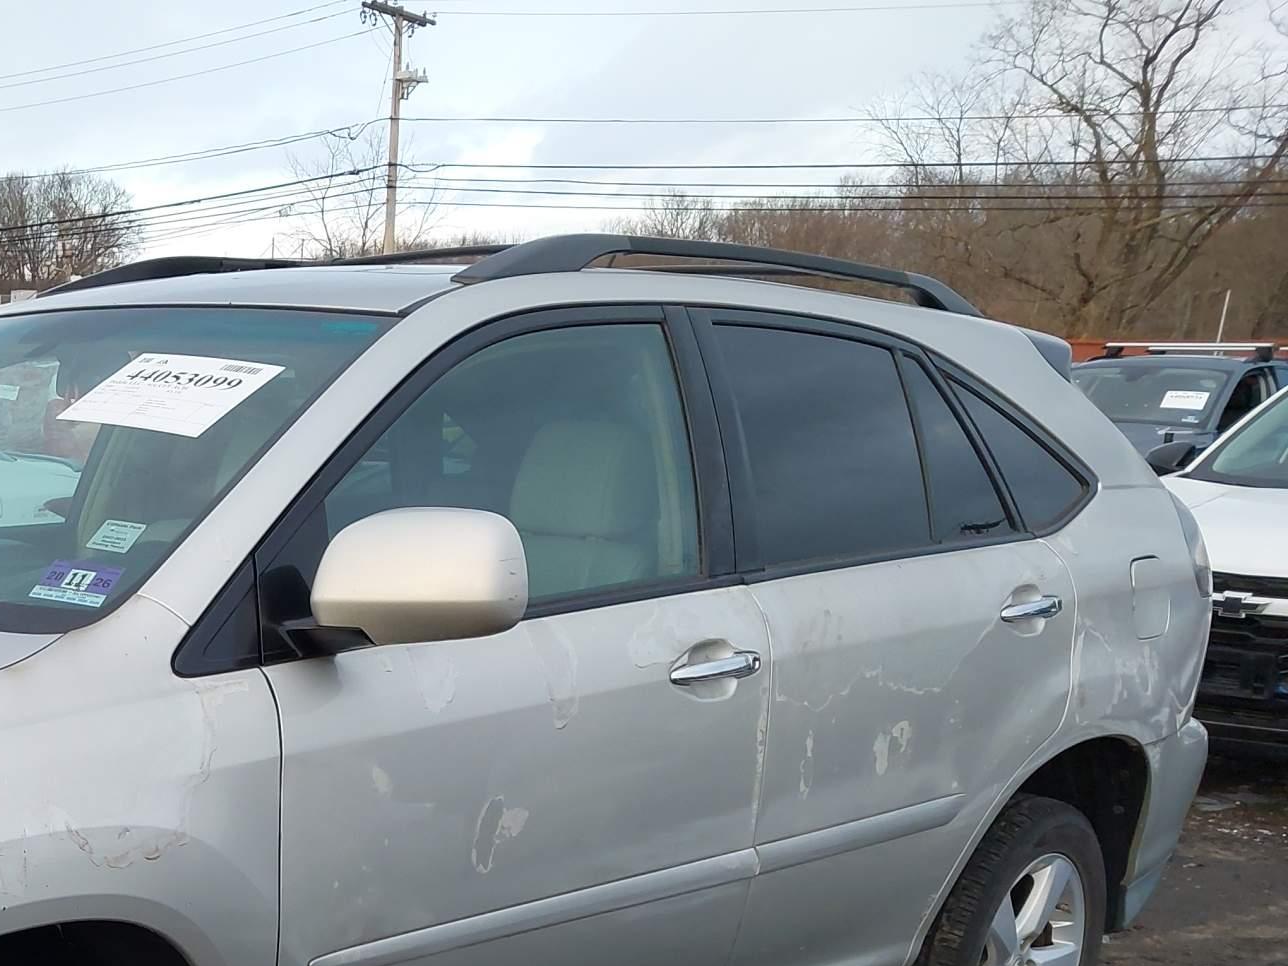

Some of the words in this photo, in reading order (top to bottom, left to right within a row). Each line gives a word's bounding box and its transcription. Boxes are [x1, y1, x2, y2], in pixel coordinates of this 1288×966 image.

[126, 368, 243, 391] 44053099
[45, 570, 65, 581] 20
[93, 577, 113, 589] 26
